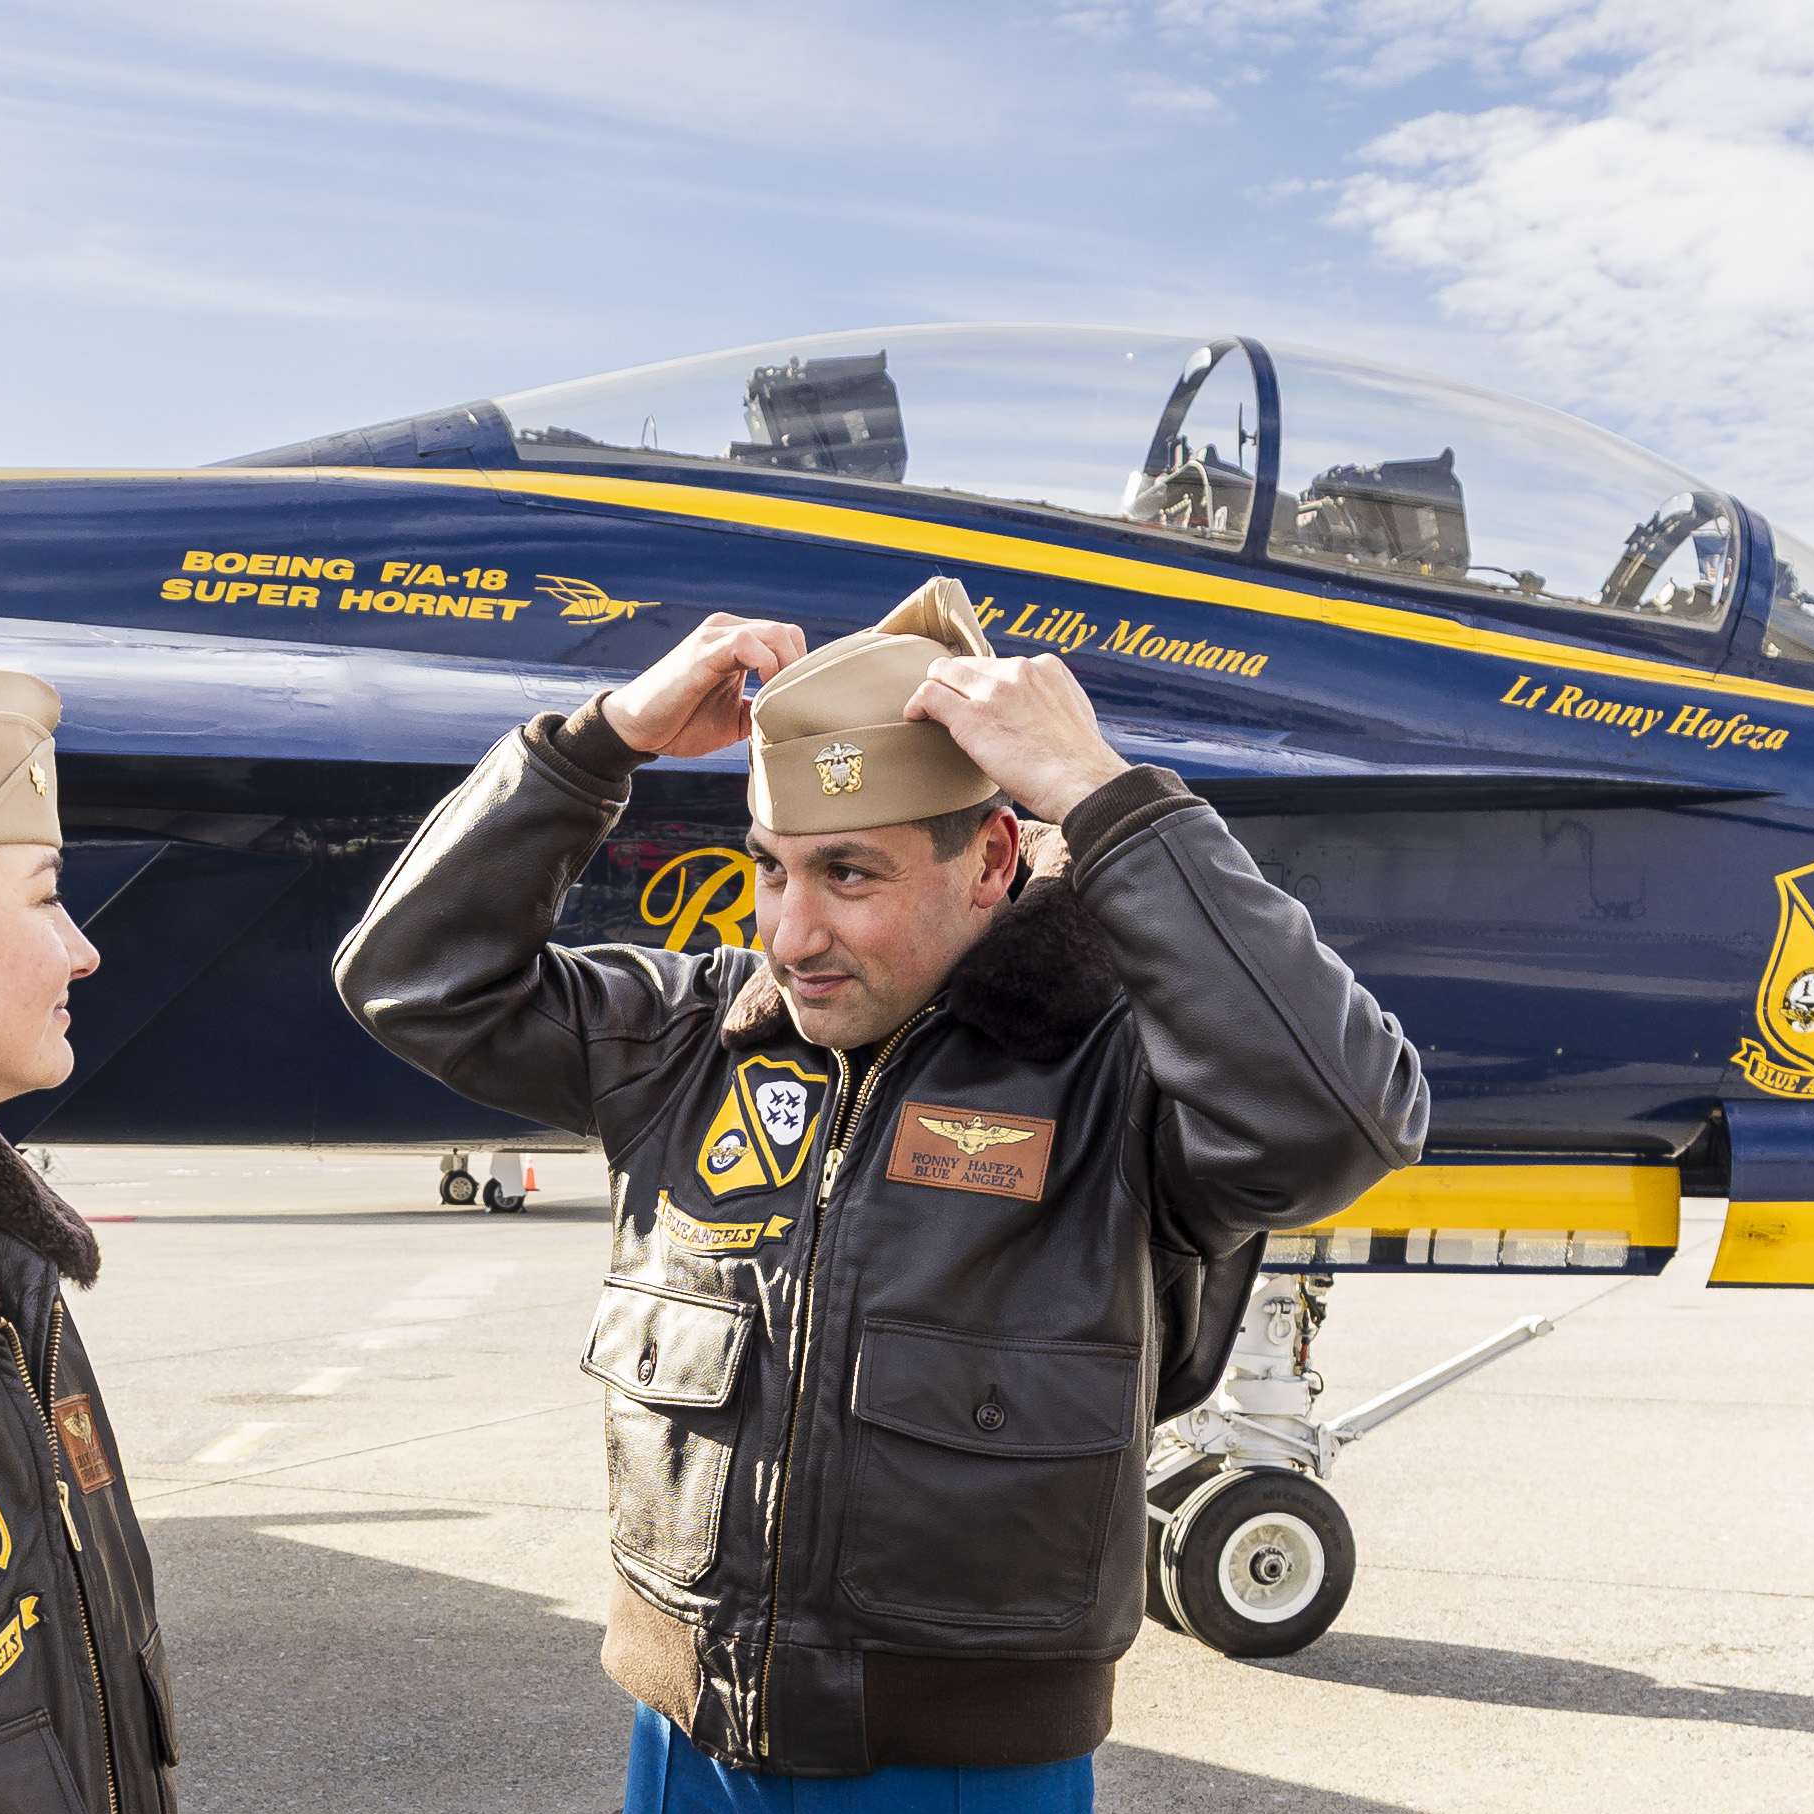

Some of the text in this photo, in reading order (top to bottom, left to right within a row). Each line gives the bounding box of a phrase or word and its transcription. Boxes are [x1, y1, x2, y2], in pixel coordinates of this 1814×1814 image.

[182, 550, 508, 591] BOEING F/A-18
[159, 578, 532, 621] SUPER HORNET
[1004, 603, 1098, 654] Lilly
[1097, 618, 1270, 678] Montana
[1499, 675, 1790, 750] Lt Ronny Hafeza
[1753, 1060, 1801, 1092] BLUE
[911, 1152, 1025, 1179] RONNY HAFEZA
[914, 1165, 1017, 1190] BLUE ANGELS
